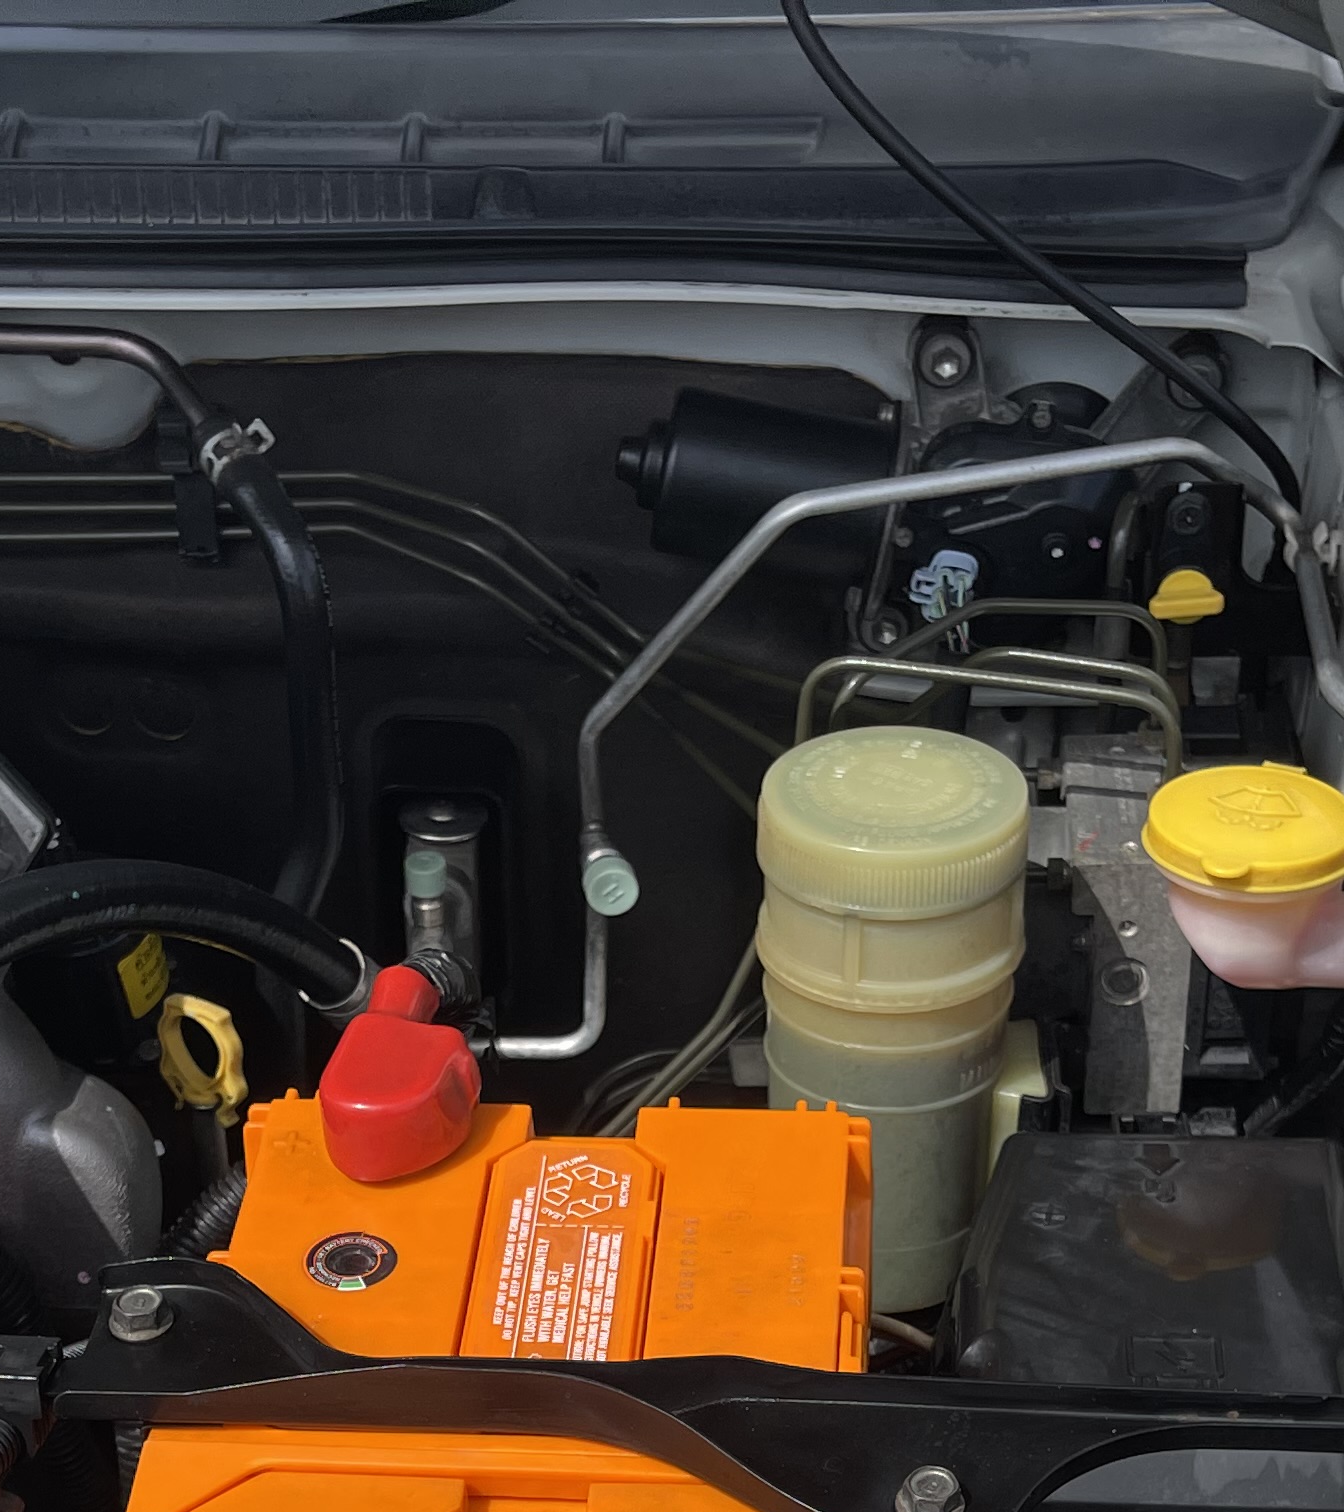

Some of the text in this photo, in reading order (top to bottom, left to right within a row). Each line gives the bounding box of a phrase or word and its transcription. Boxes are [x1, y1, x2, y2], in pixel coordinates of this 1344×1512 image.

[547, 1155, 588, 1173] RETURN
[522, 1238, 551, 1343] FLUSH EYES IMMEDIATELY
[537, 1320, 552, 1342] WITH
[546, 1270, 560, 1286] GET
[552, 1263, 575, 1343] MEDICAL HELP FAST
